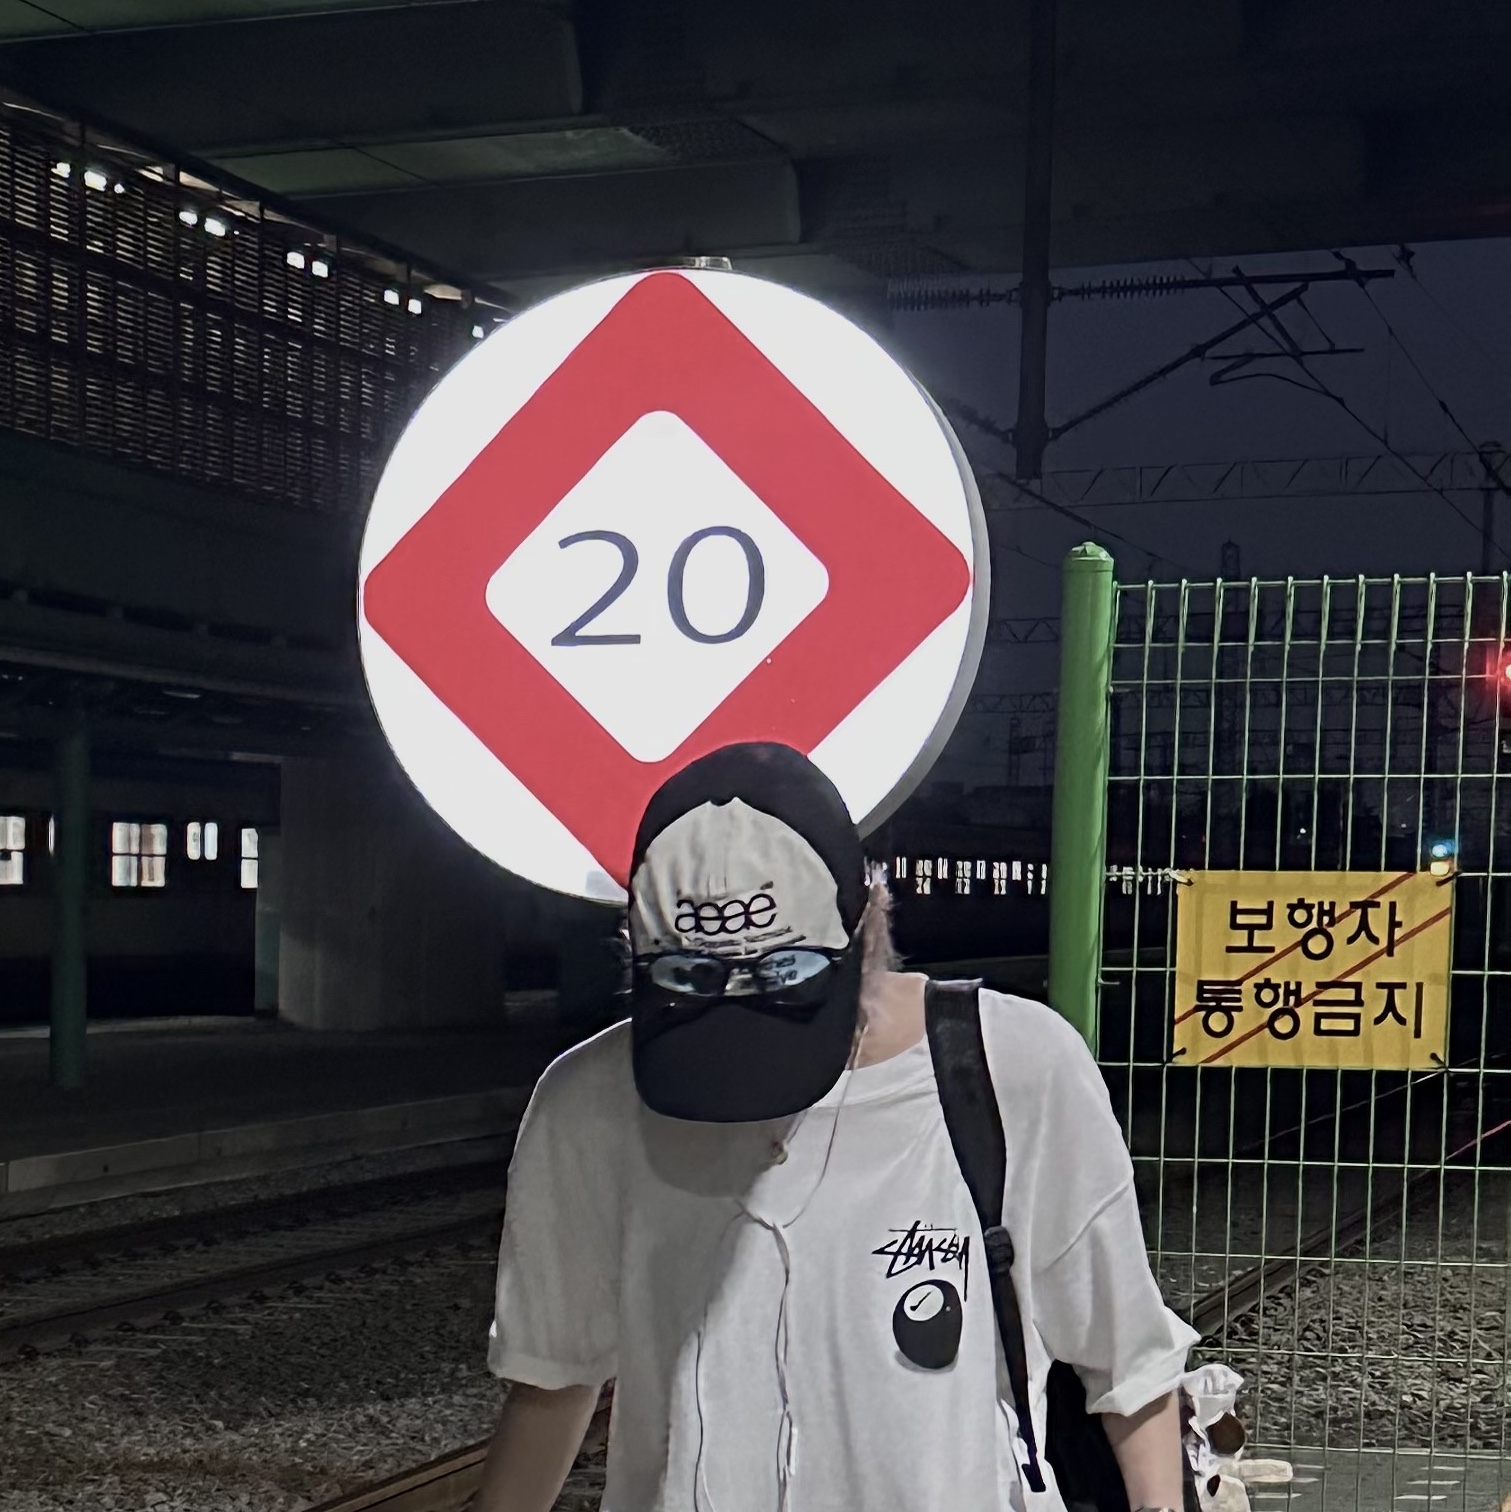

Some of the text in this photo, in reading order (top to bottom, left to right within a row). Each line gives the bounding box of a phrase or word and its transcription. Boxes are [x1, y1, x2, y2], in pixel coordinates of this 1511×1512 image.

[550, 525, 766, 647] 20
[1225, 898, 1402, 960] 보행자
[1195, 978, 1424, 1040] 통행금지
